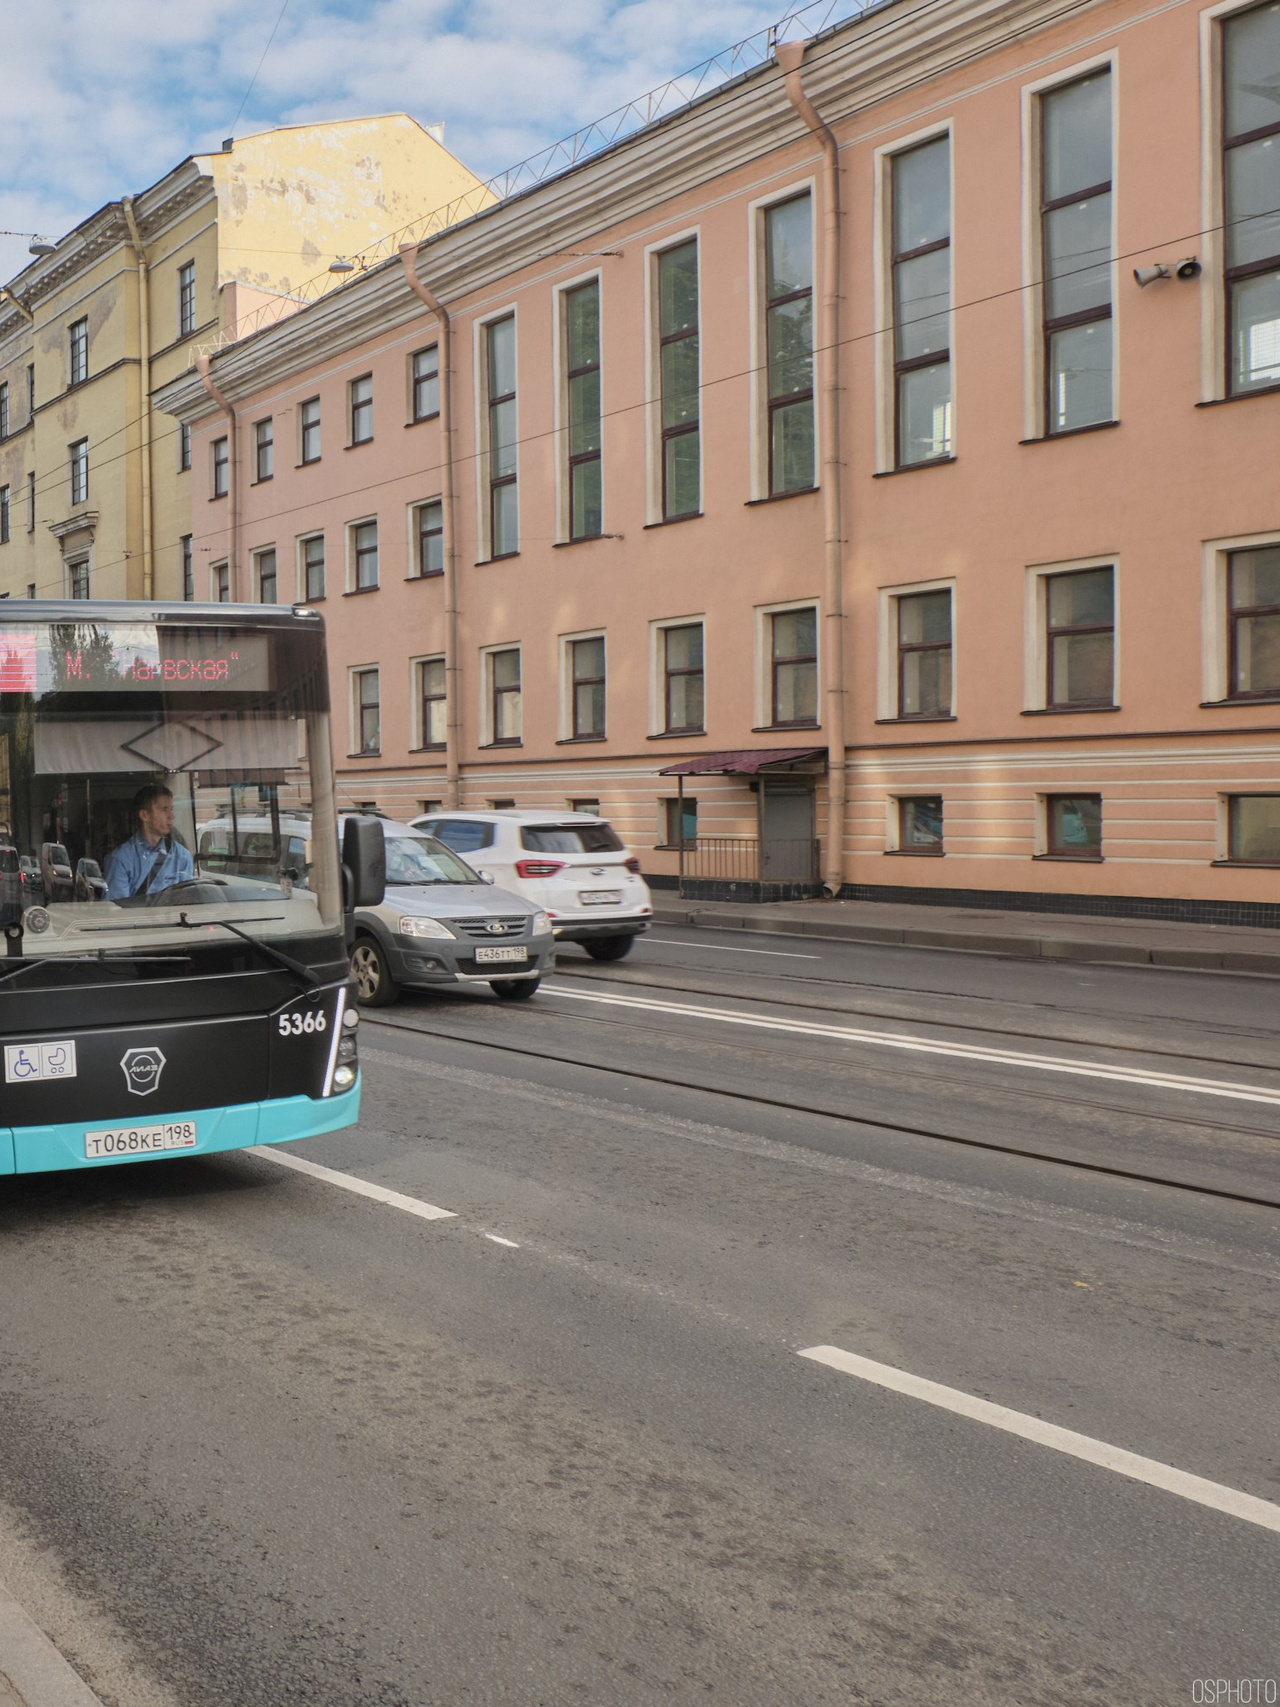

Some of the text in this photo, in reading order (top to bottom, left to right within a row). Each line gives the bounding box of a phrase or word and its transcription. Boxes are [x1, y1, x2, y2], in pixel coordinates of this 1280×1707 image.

[66, 650, 90, 680] М.
[278, 1010, 327, 1036] 5366
[166, 1124, 192, 1140] 198
